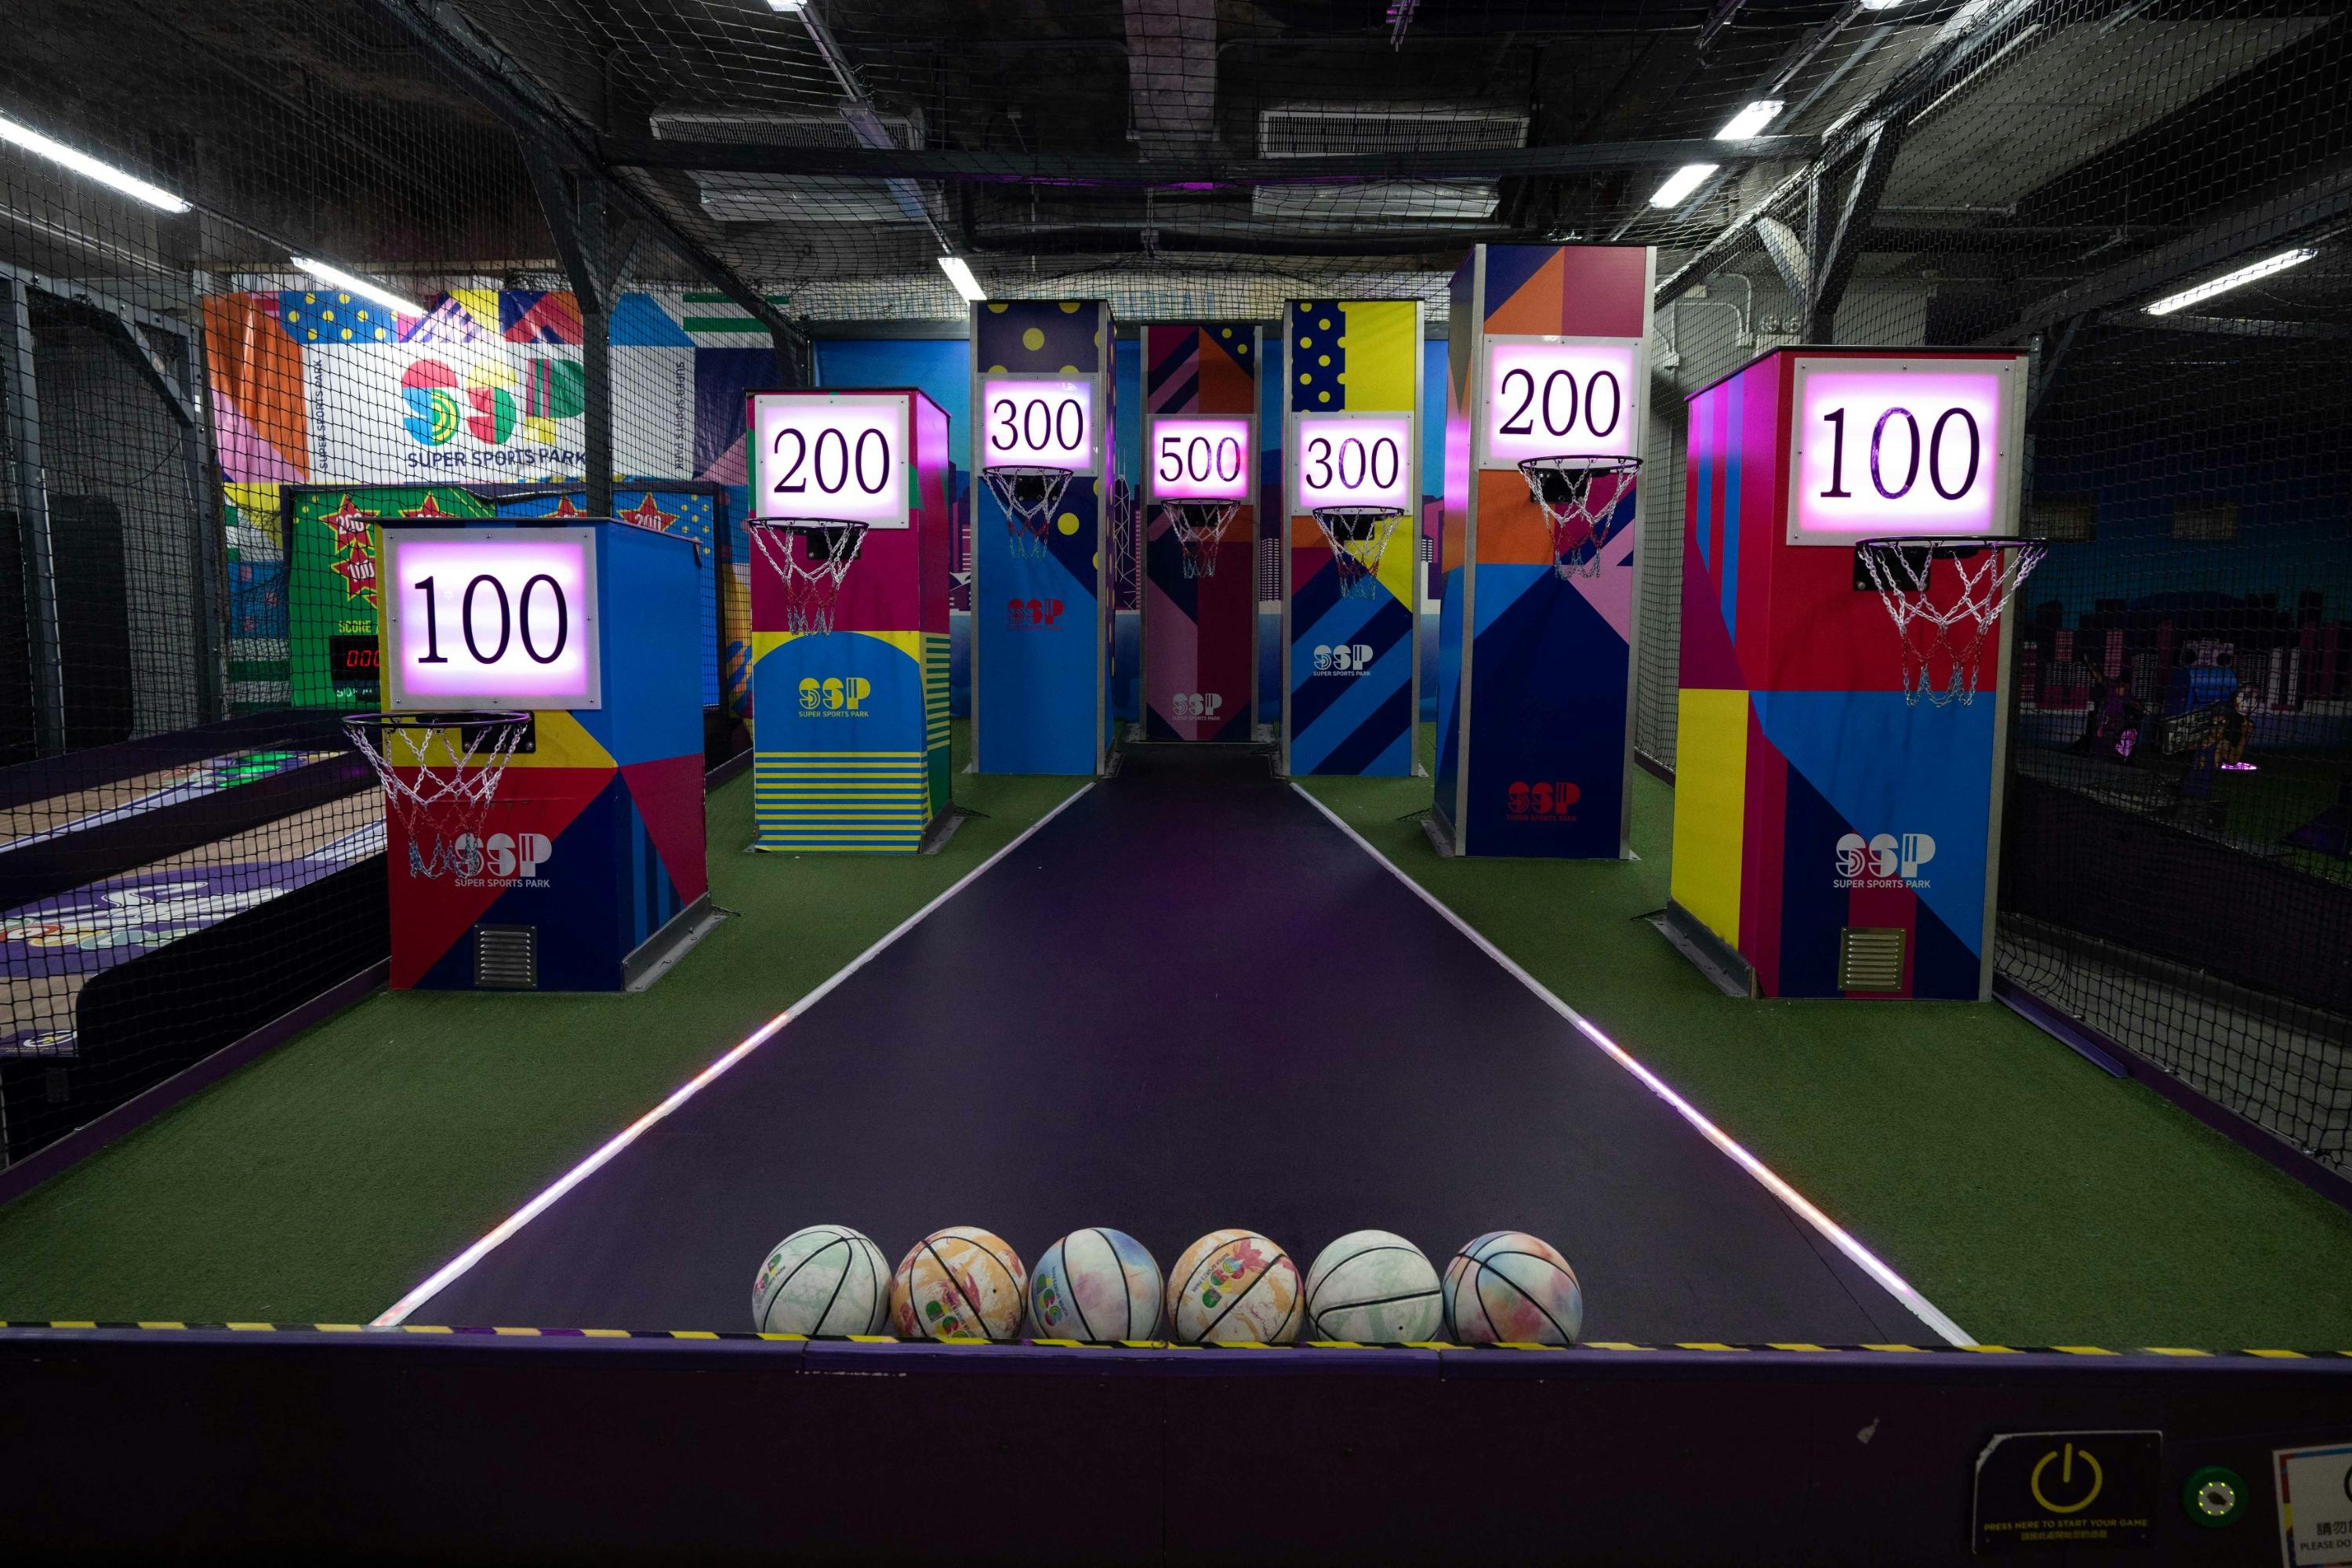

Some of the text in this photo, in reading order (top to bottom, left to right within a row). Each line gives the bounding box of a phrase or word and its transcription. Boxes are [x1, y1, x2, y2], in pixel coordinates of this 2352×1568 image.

[313, 360, 328, 469] SUPER SPORTS PARK
[401, 358, 584, 446] SSP
[1500, 369, 1620, 437] 200
[992, 399, 1083, 450] 300
[408, 448, 586, 468] SUPER SPORTS PARK
[775, 428, 889, 494] 200
[1160, 437, 1240, 481] 500
[1306, 438, 1398, 488] 300
[1821, 408, 1980, 500] 100
[339, 620, 372, 633] SCORE
[416, 575, 567, 664] 100
[1314, 644, 1374, 670] SSP
[799, 677, 871, 710] SSP
[1172, 693, 1223, 716] SSP
[1507, 781, 1581, 815] SSP
[454, 833, 552, 877] SSP
[1835, 833, 1936, 878] SSP
[455, 879, 551, 887] SUPER SPORTS PARK
[1833, 879, 1931, 888] SUPER SPORTS PARK
[1984, 1518, 2147, 1532] PRESS HERE TO START YOUR GAME
[2300, 1539, 2351, 1551] PLEASE DO
